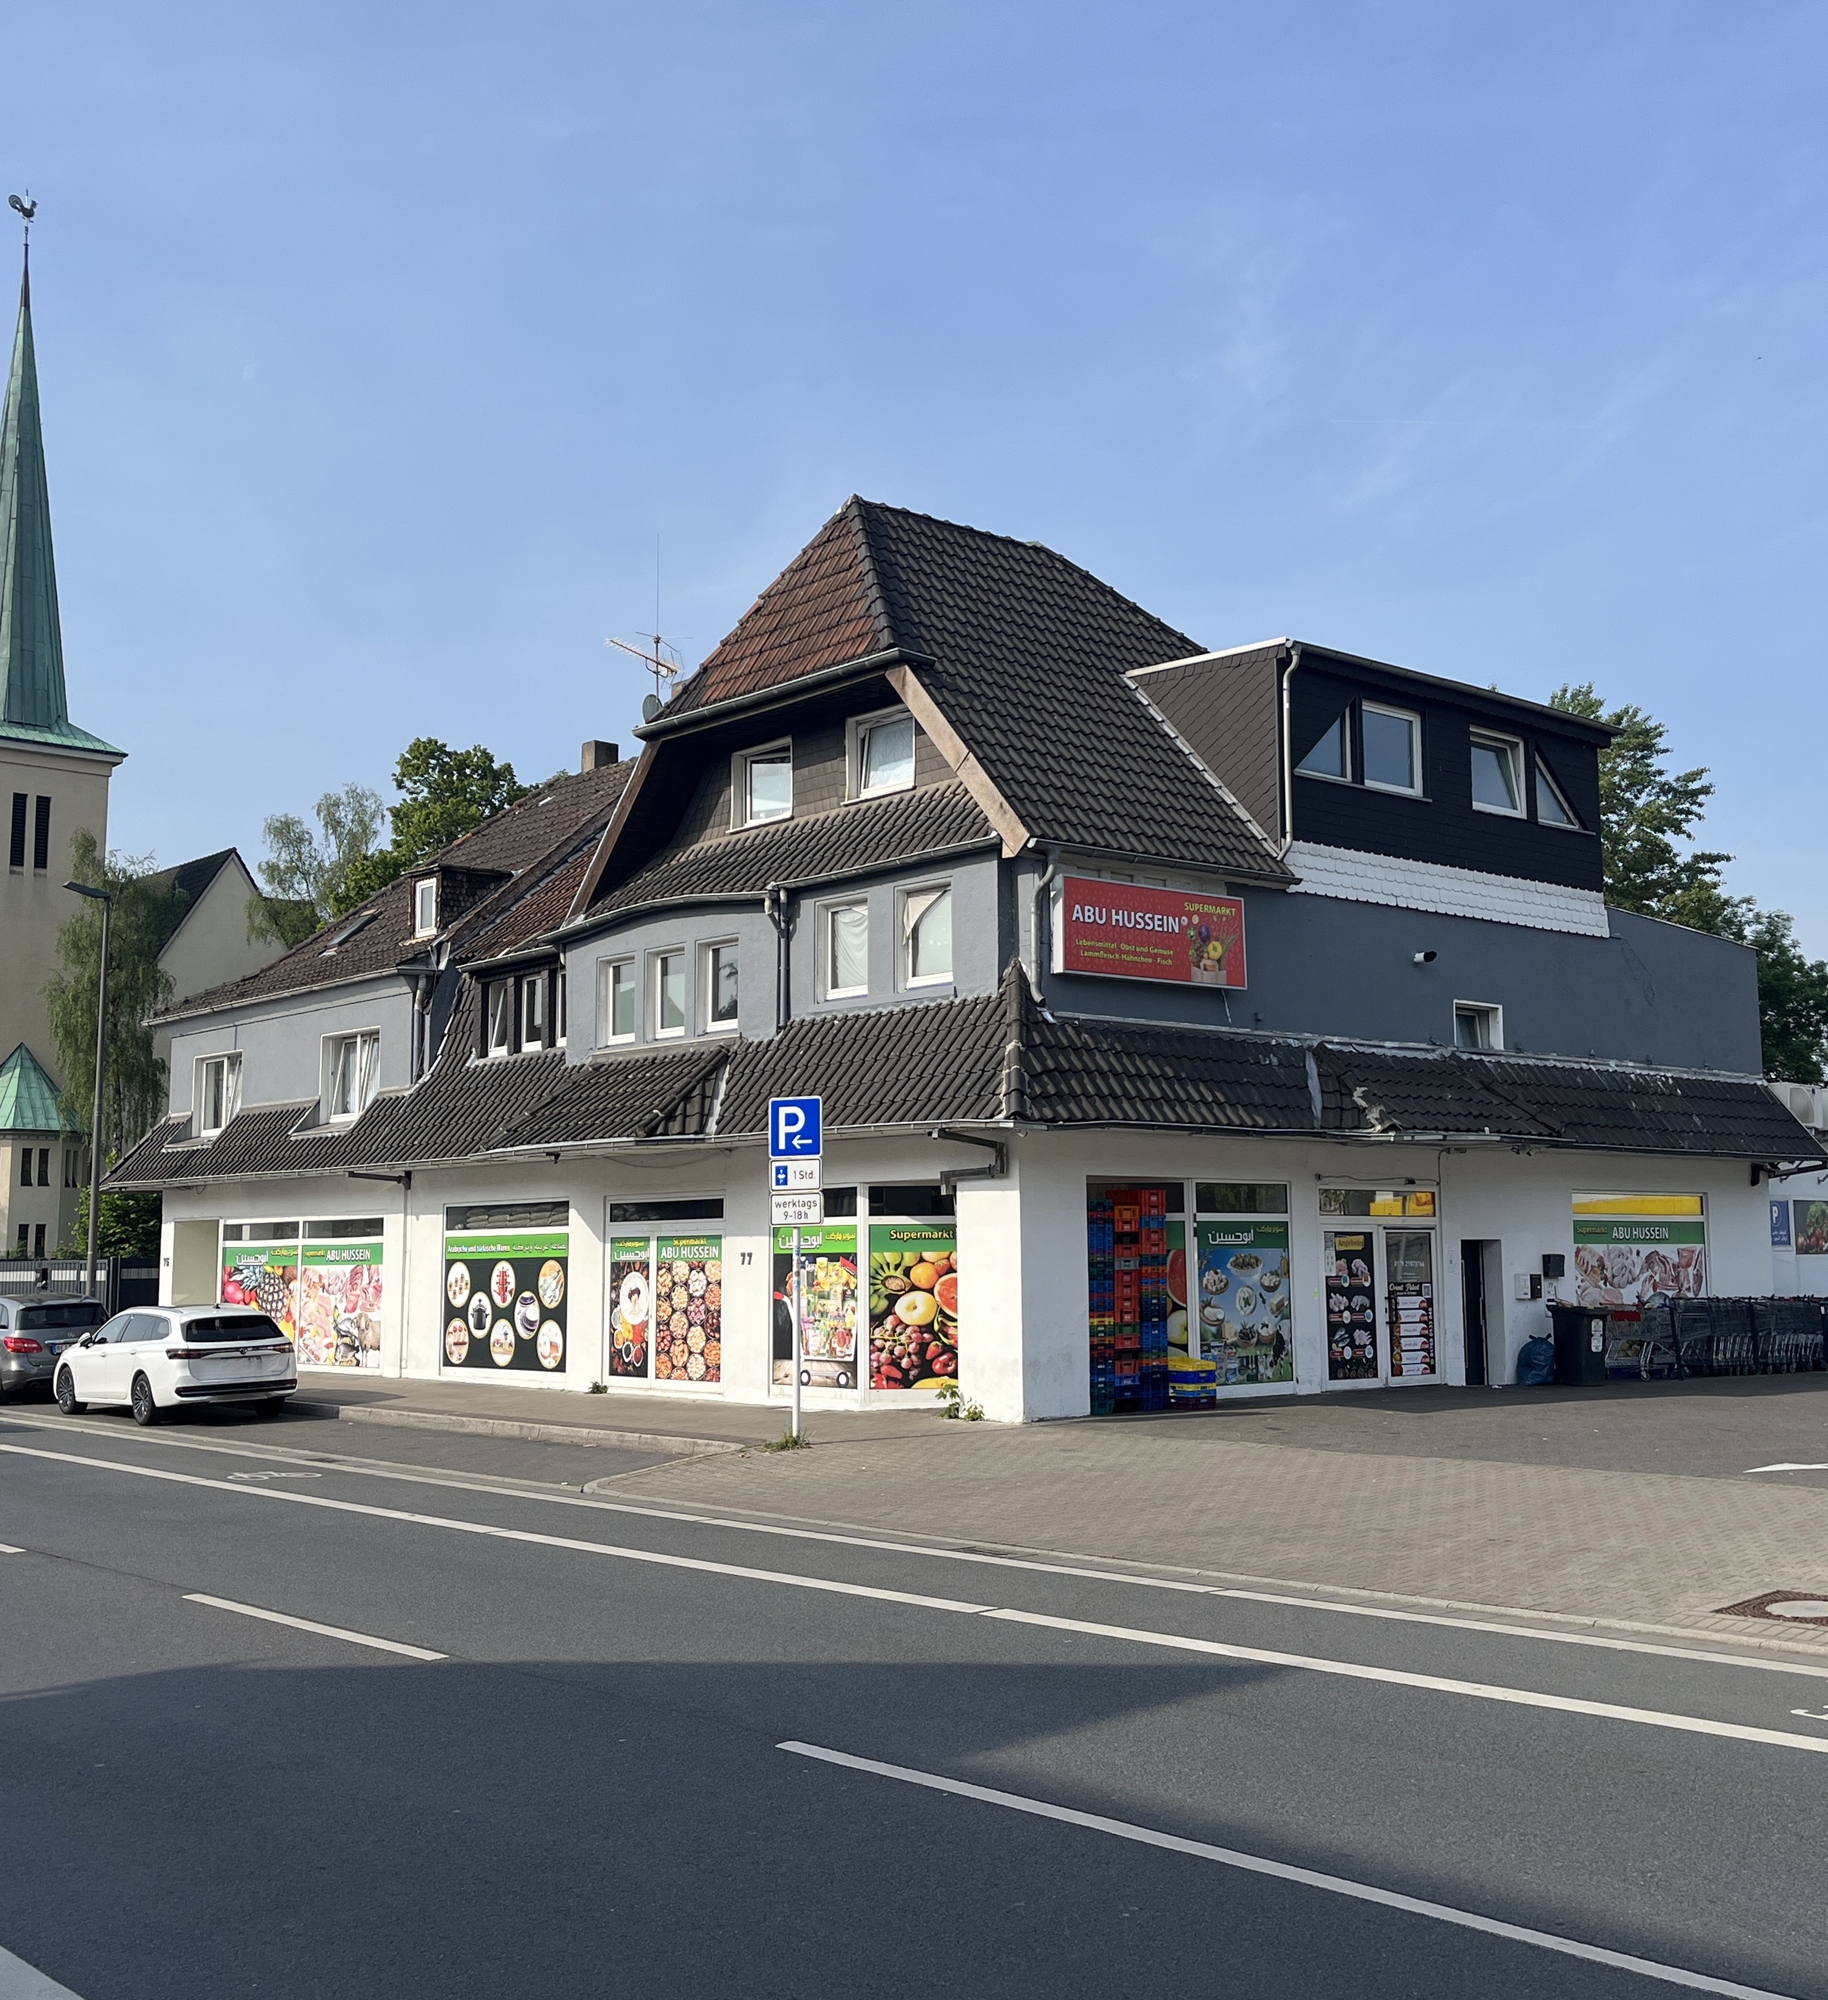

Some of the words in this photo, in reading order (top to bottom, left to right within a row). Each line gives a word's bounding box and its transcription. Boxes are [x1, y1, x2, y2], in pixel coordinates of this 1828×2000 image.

[1184, 901, 1236, 917] SUPERMARKT
[1072, 904, 1107, 925] ABU
[1111, 908, 1180, 934] HUSSEIN
[1075, 938, 1117, 949] Lebensmittel
[1120, 943, 1135, 952] Obst
[1136, 945, 1149, 953] und
[1080, 949, 1120, 960] Lammfleisch
[1157, 957, 1173, 966] Fisch
[778, 1106, 806, 1150] P
[793, 1170, 797, 1180] 1
[798, 1170, 815, 1180] Std.
[774, 1199, 817, 1210] werktags
[783, 1210, 802, 1220] 9-18
[803, 1210, 809, 1220] h
[1772, 1205, 1779, 1224] P
[890, 1229, 954, 1242] Supermarkt
[1207, 1226, 1254, 1244] أبوحسين
[1576, 1225, 1607, 1235] Supermarkt
[1612, 1227, 1631, 1239] ABU
[1632, 1227, 1669, 1239] HUSSEIN
[672, 1237, 707, 1248] Supermarkt
[326, 1249, 341, 1261] ABU
[341, 1248, 371, 1261] HUSSEIN
[660, 1246, 679, 1259] ABU
[680, 1245, 719, 1259] HUSSEIN
[740, 1252, 753, 1266] 77
